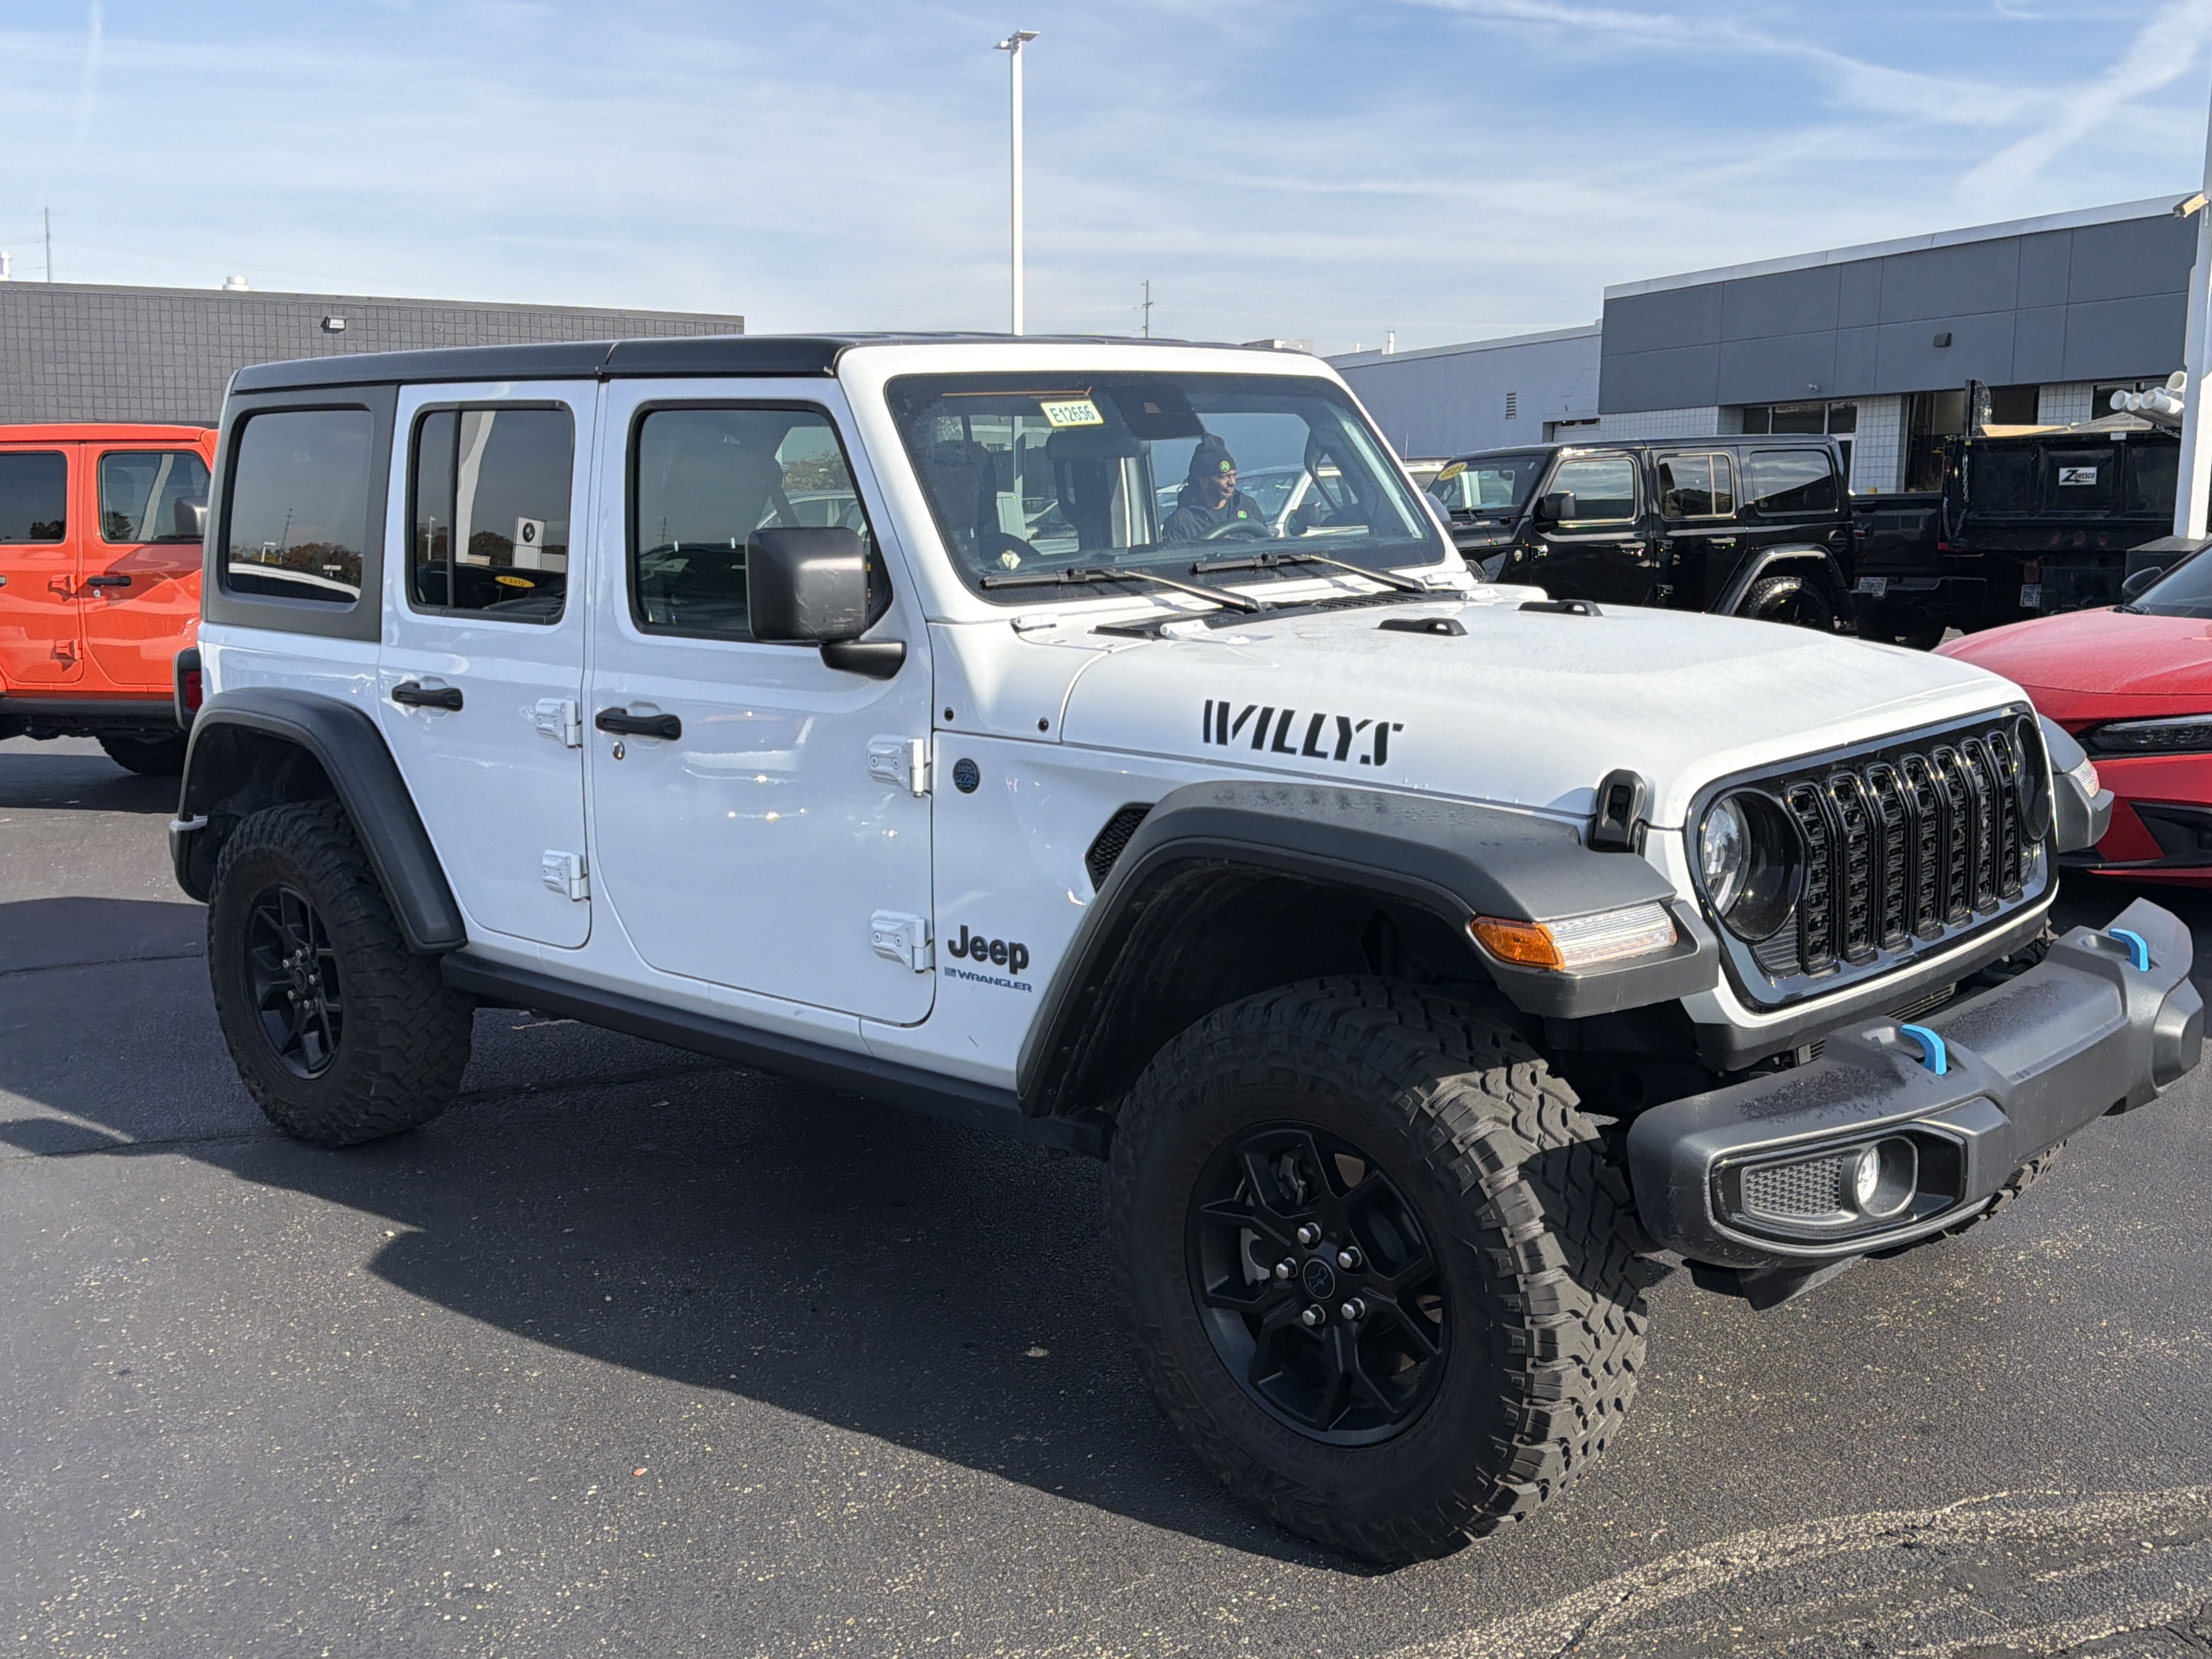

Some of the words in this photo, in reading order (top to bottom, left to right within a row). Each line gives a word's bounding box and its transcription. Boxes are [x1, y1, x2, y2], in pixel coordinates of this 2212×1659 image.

[1049, 404, 1096, 424] E12656
[1203, 699, 1404, 766] WILLYS
[947, 924, 1030, 975] Jeep
[957, 969, 1033, 992] WRANGLER
